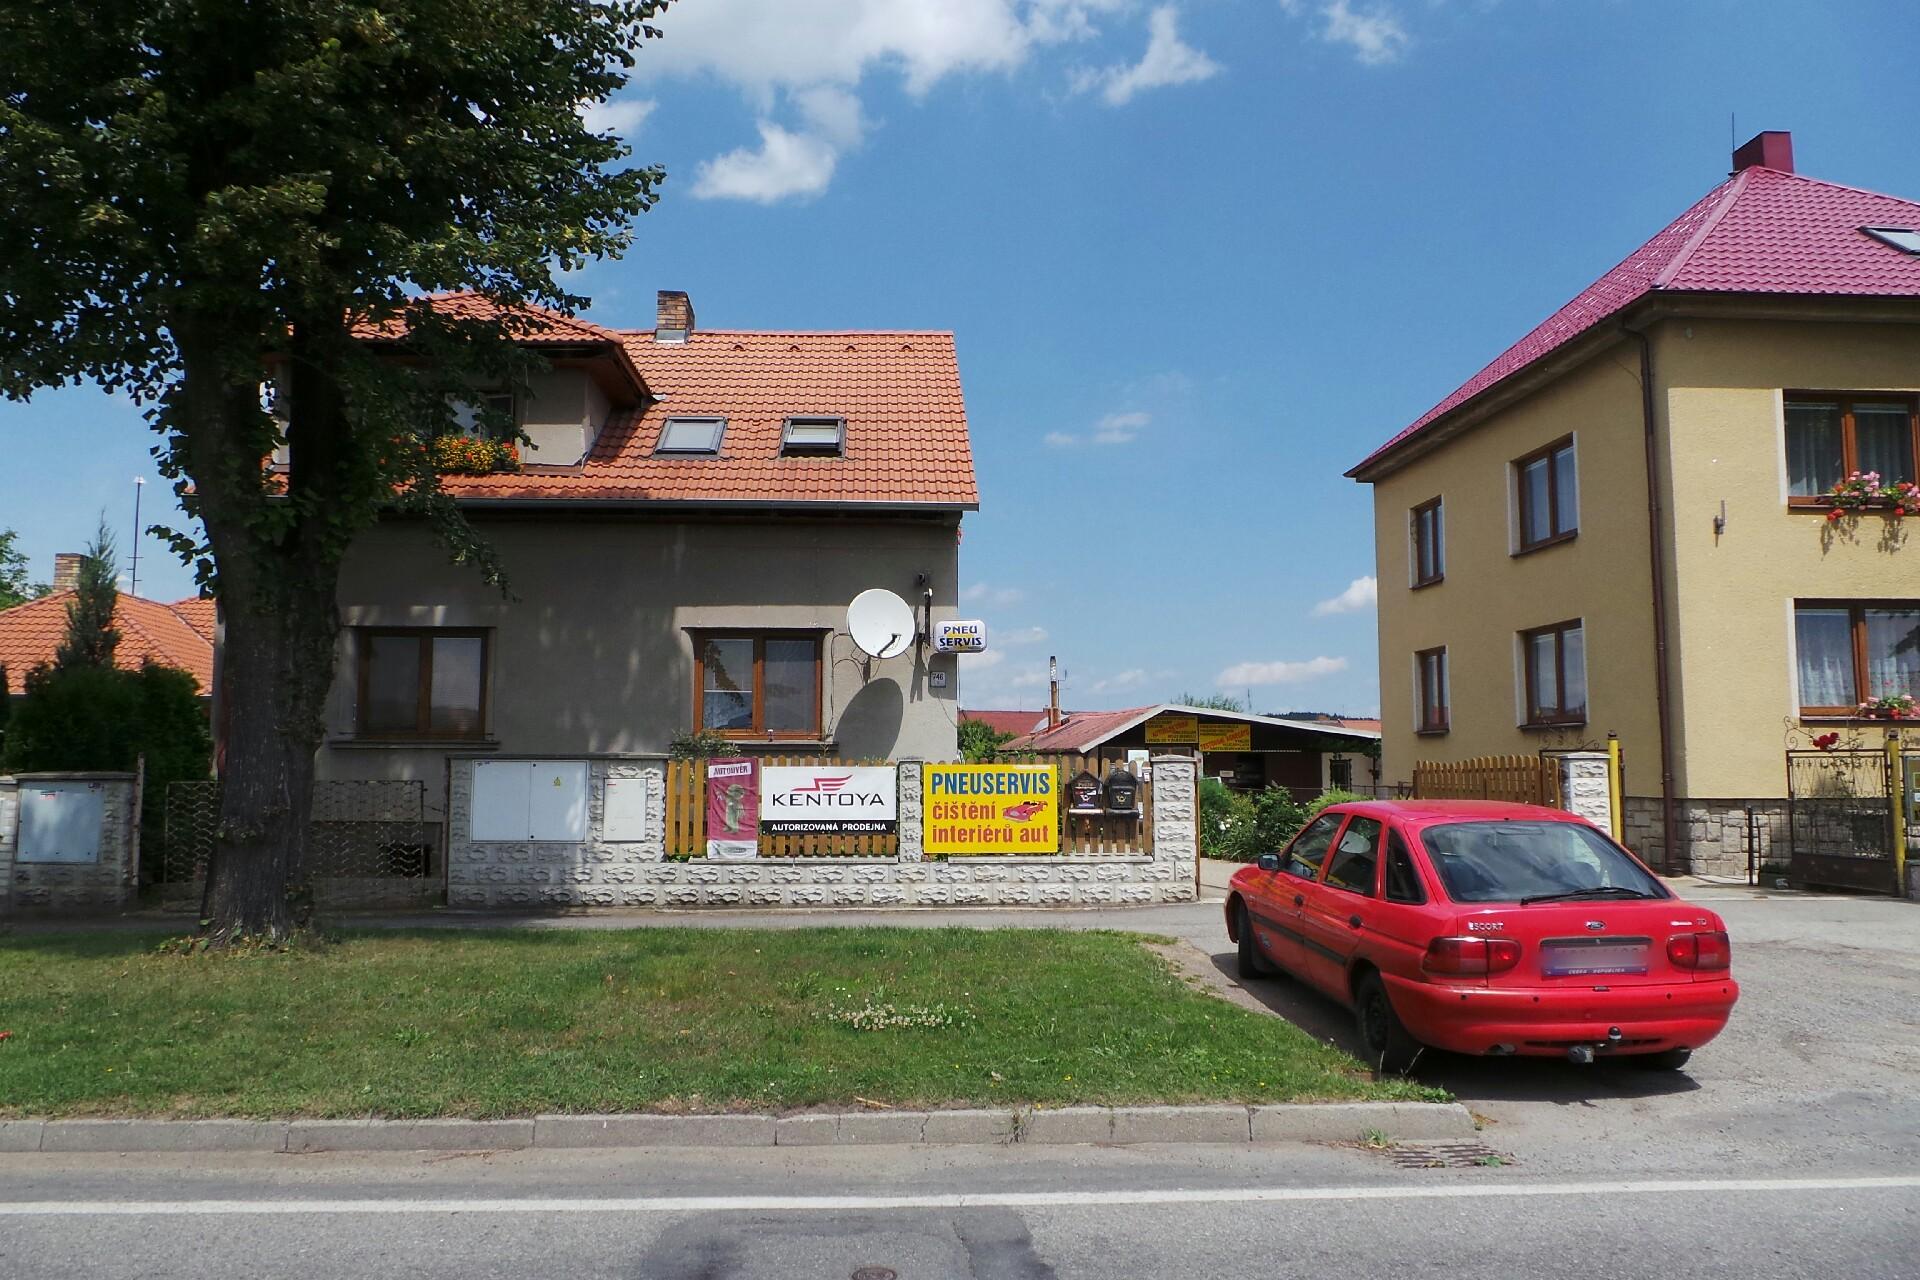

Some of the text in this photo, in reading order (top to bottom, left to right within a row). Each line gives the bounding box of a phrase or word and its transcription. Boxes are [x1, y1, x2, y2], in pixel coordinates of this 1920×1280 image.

[943, 625, 977, 635] PNEU
[939, 637, 982, 647] SERVIS
[932, 673, 944, 681] 746
[931, 772, 1050, 795] PNEUSERVIS
[772, 793, 885, 806] KENTOYA
[932, 801, 996, 820] čištění
[771, 822, 887, 831] AUTORIZOVANÁ PRODEJNA
[932, 824, 1049, 843] interiérů aut
[1468, 921, 1504, 930] ESCORT
